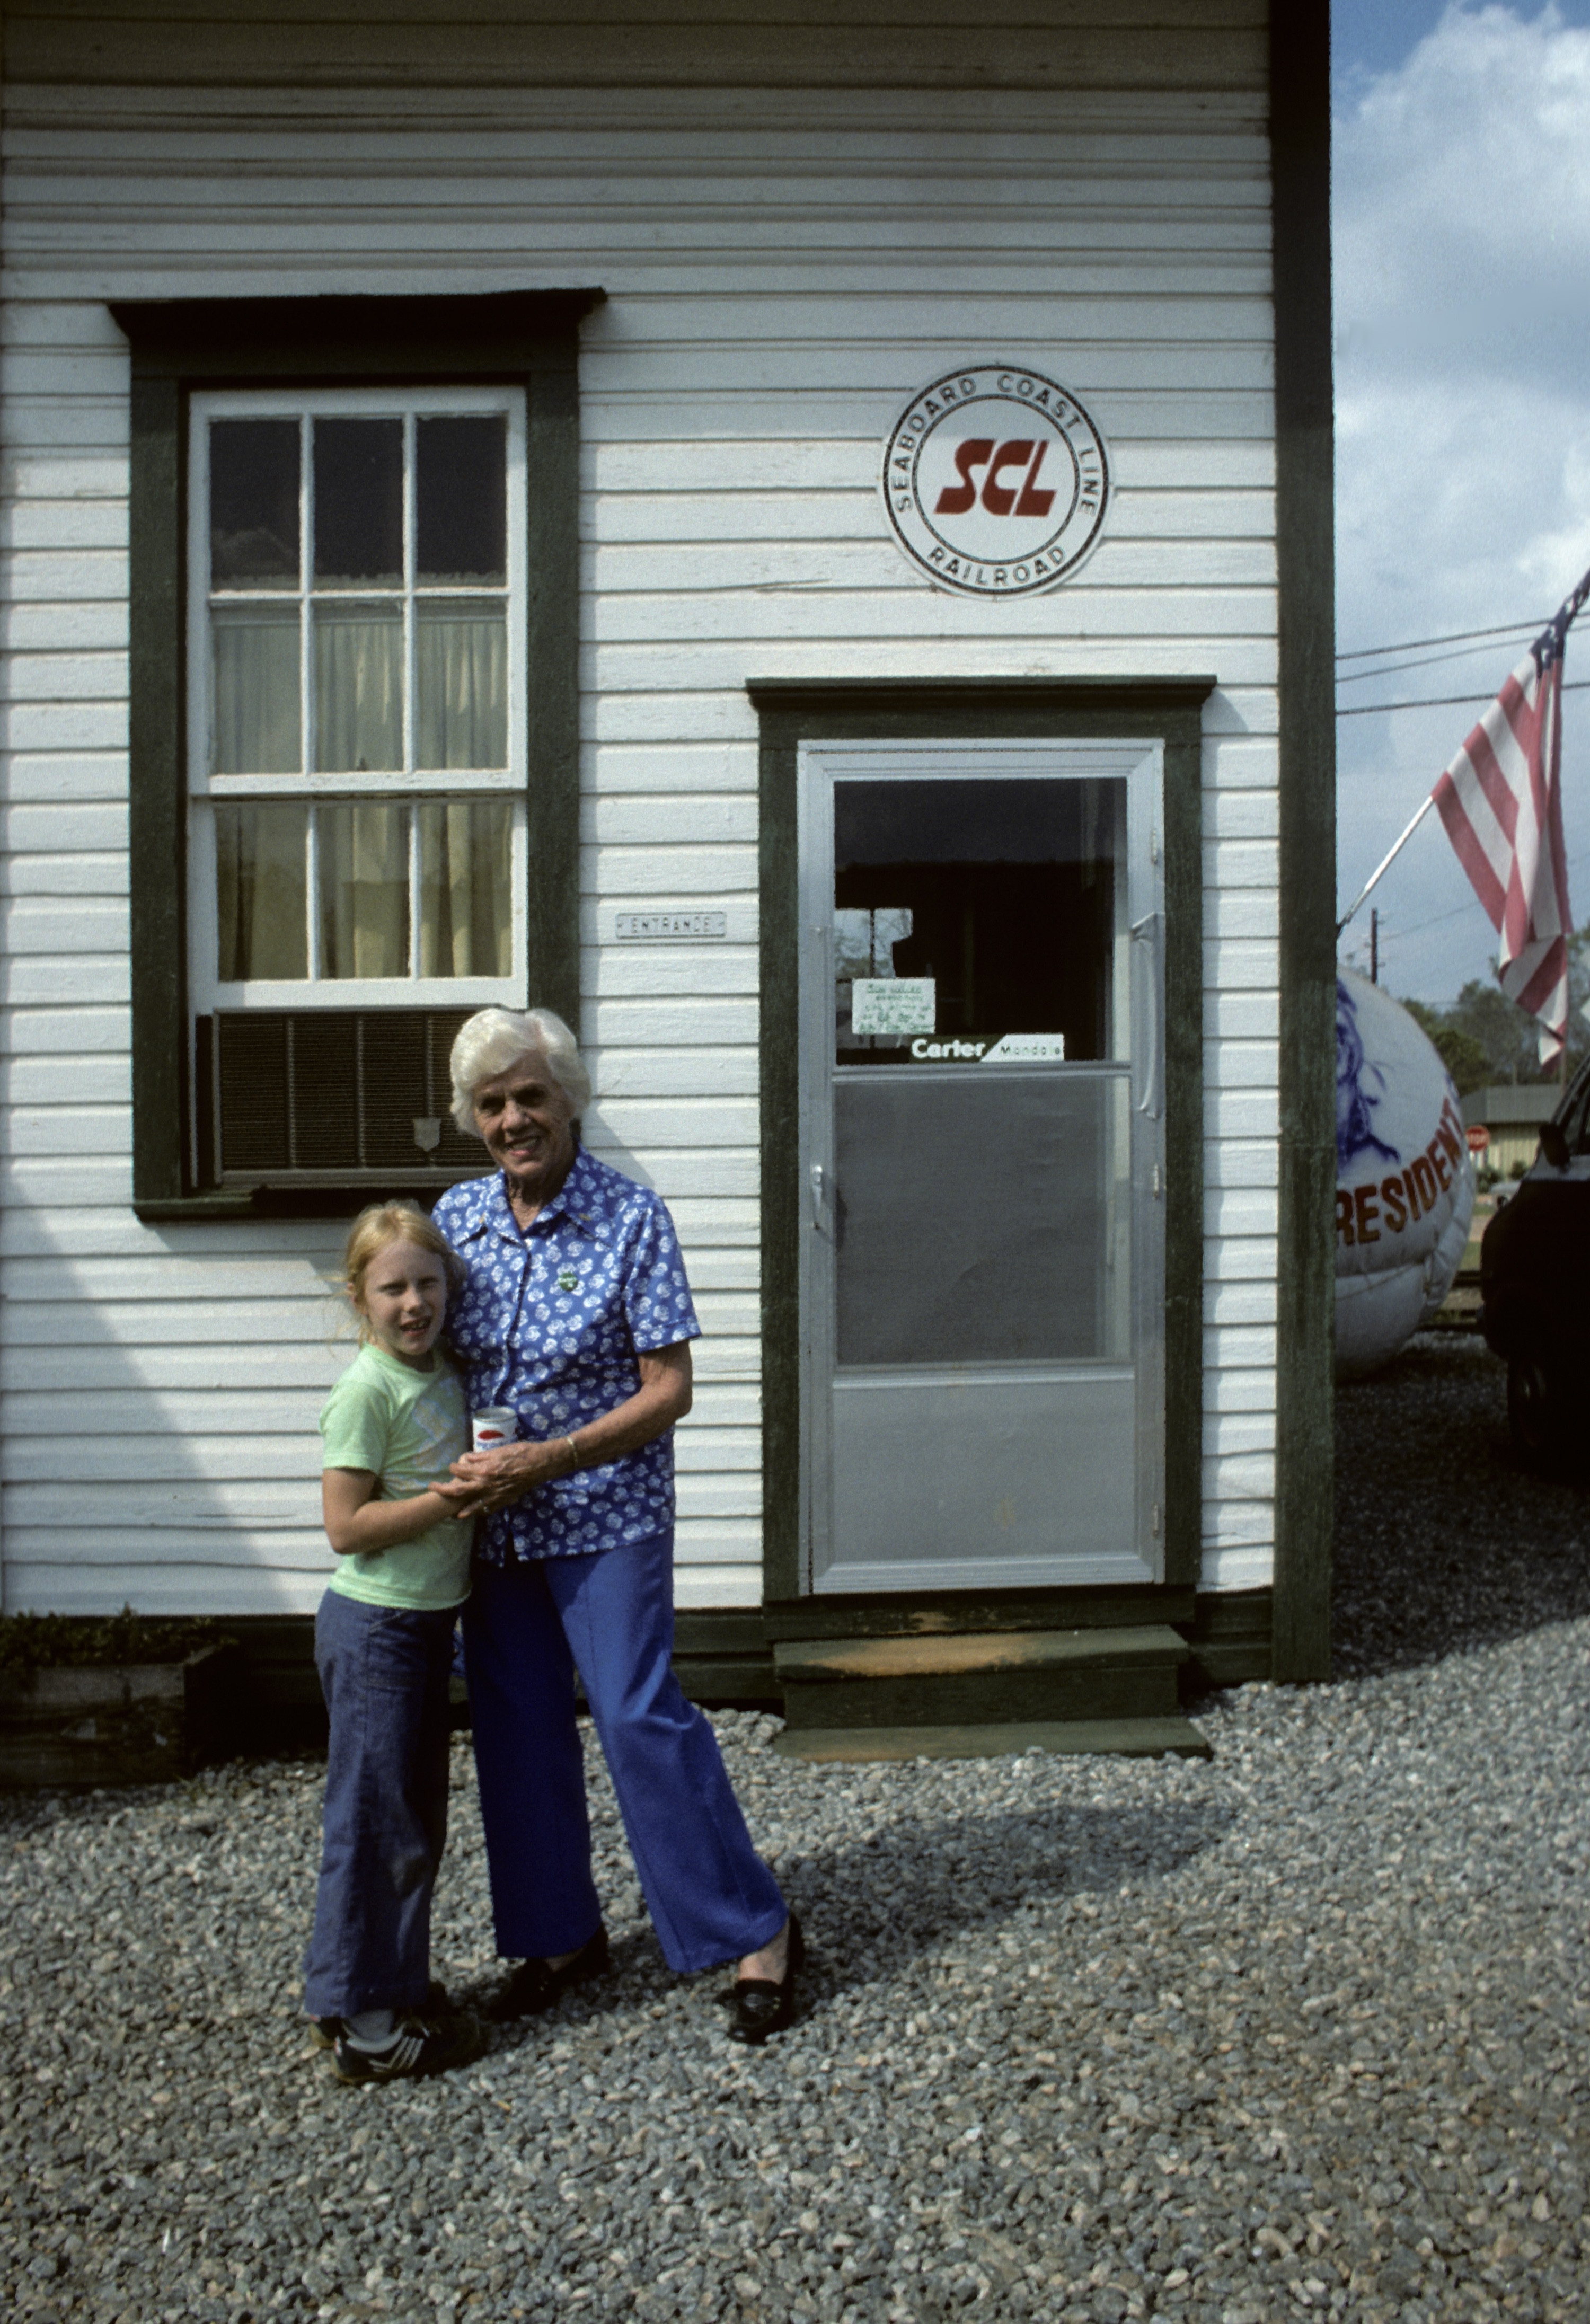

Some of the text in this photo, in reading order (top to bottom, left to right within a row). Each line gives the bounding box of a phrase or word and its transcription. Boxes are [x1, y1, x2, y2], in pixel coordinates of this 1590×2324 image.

[891, 374, 1101, 517] SEABOARD COAST LINE
[934, 438, 1057, 517] SCL
[928, 545, 1066, 587] RAILROAD
[631, 916, 711, 934] ENTRANCE
[911, 1038, 986, 1058] Carter
